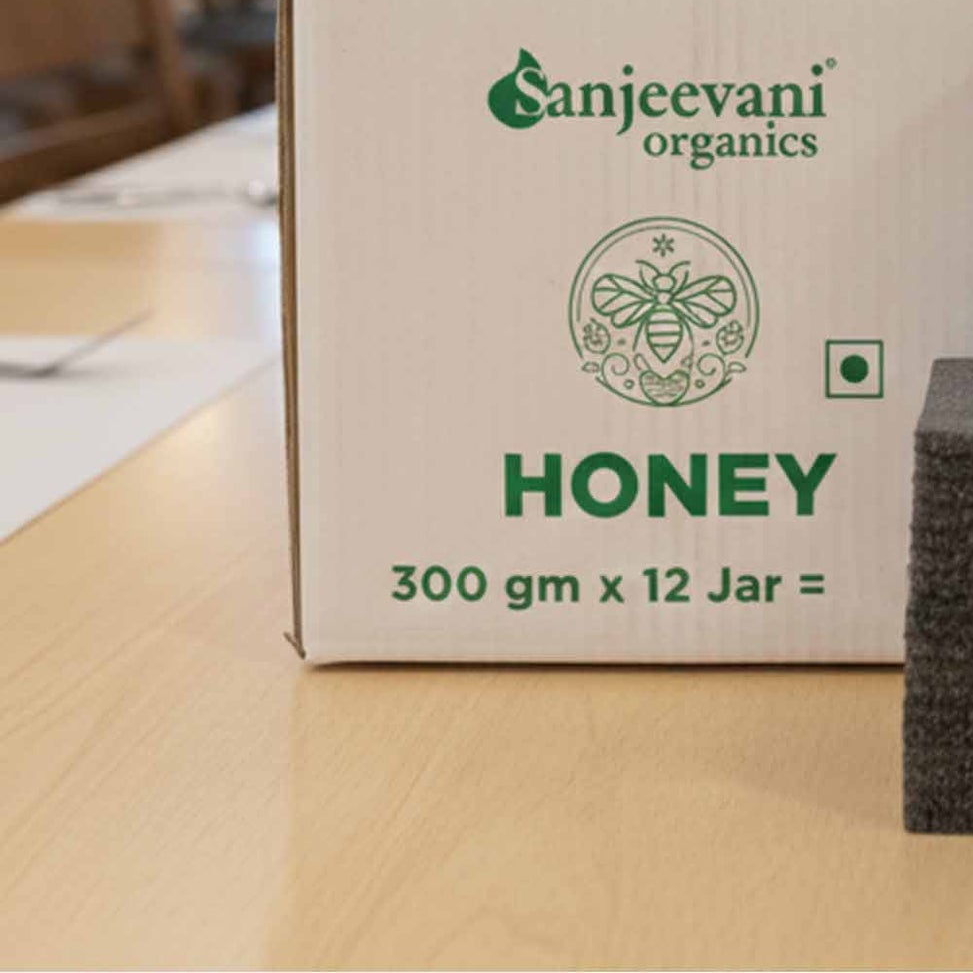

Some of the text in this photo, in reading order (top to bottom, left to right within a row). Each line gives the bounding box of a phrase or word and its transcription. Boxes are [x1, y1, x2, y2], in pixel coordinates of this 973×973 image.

[508, 64, 828, 136] Sanjeevani
[642, 120, 818, 170] organics
[503, 452, 838, 519] HONEY
[391, 565, 488, 603] 300
[504, 574, 580, 610] gm
[599, 577, 625, 603] x
[643, 568, 691, 603] 12
[707, 568, 783, 603] Jar
